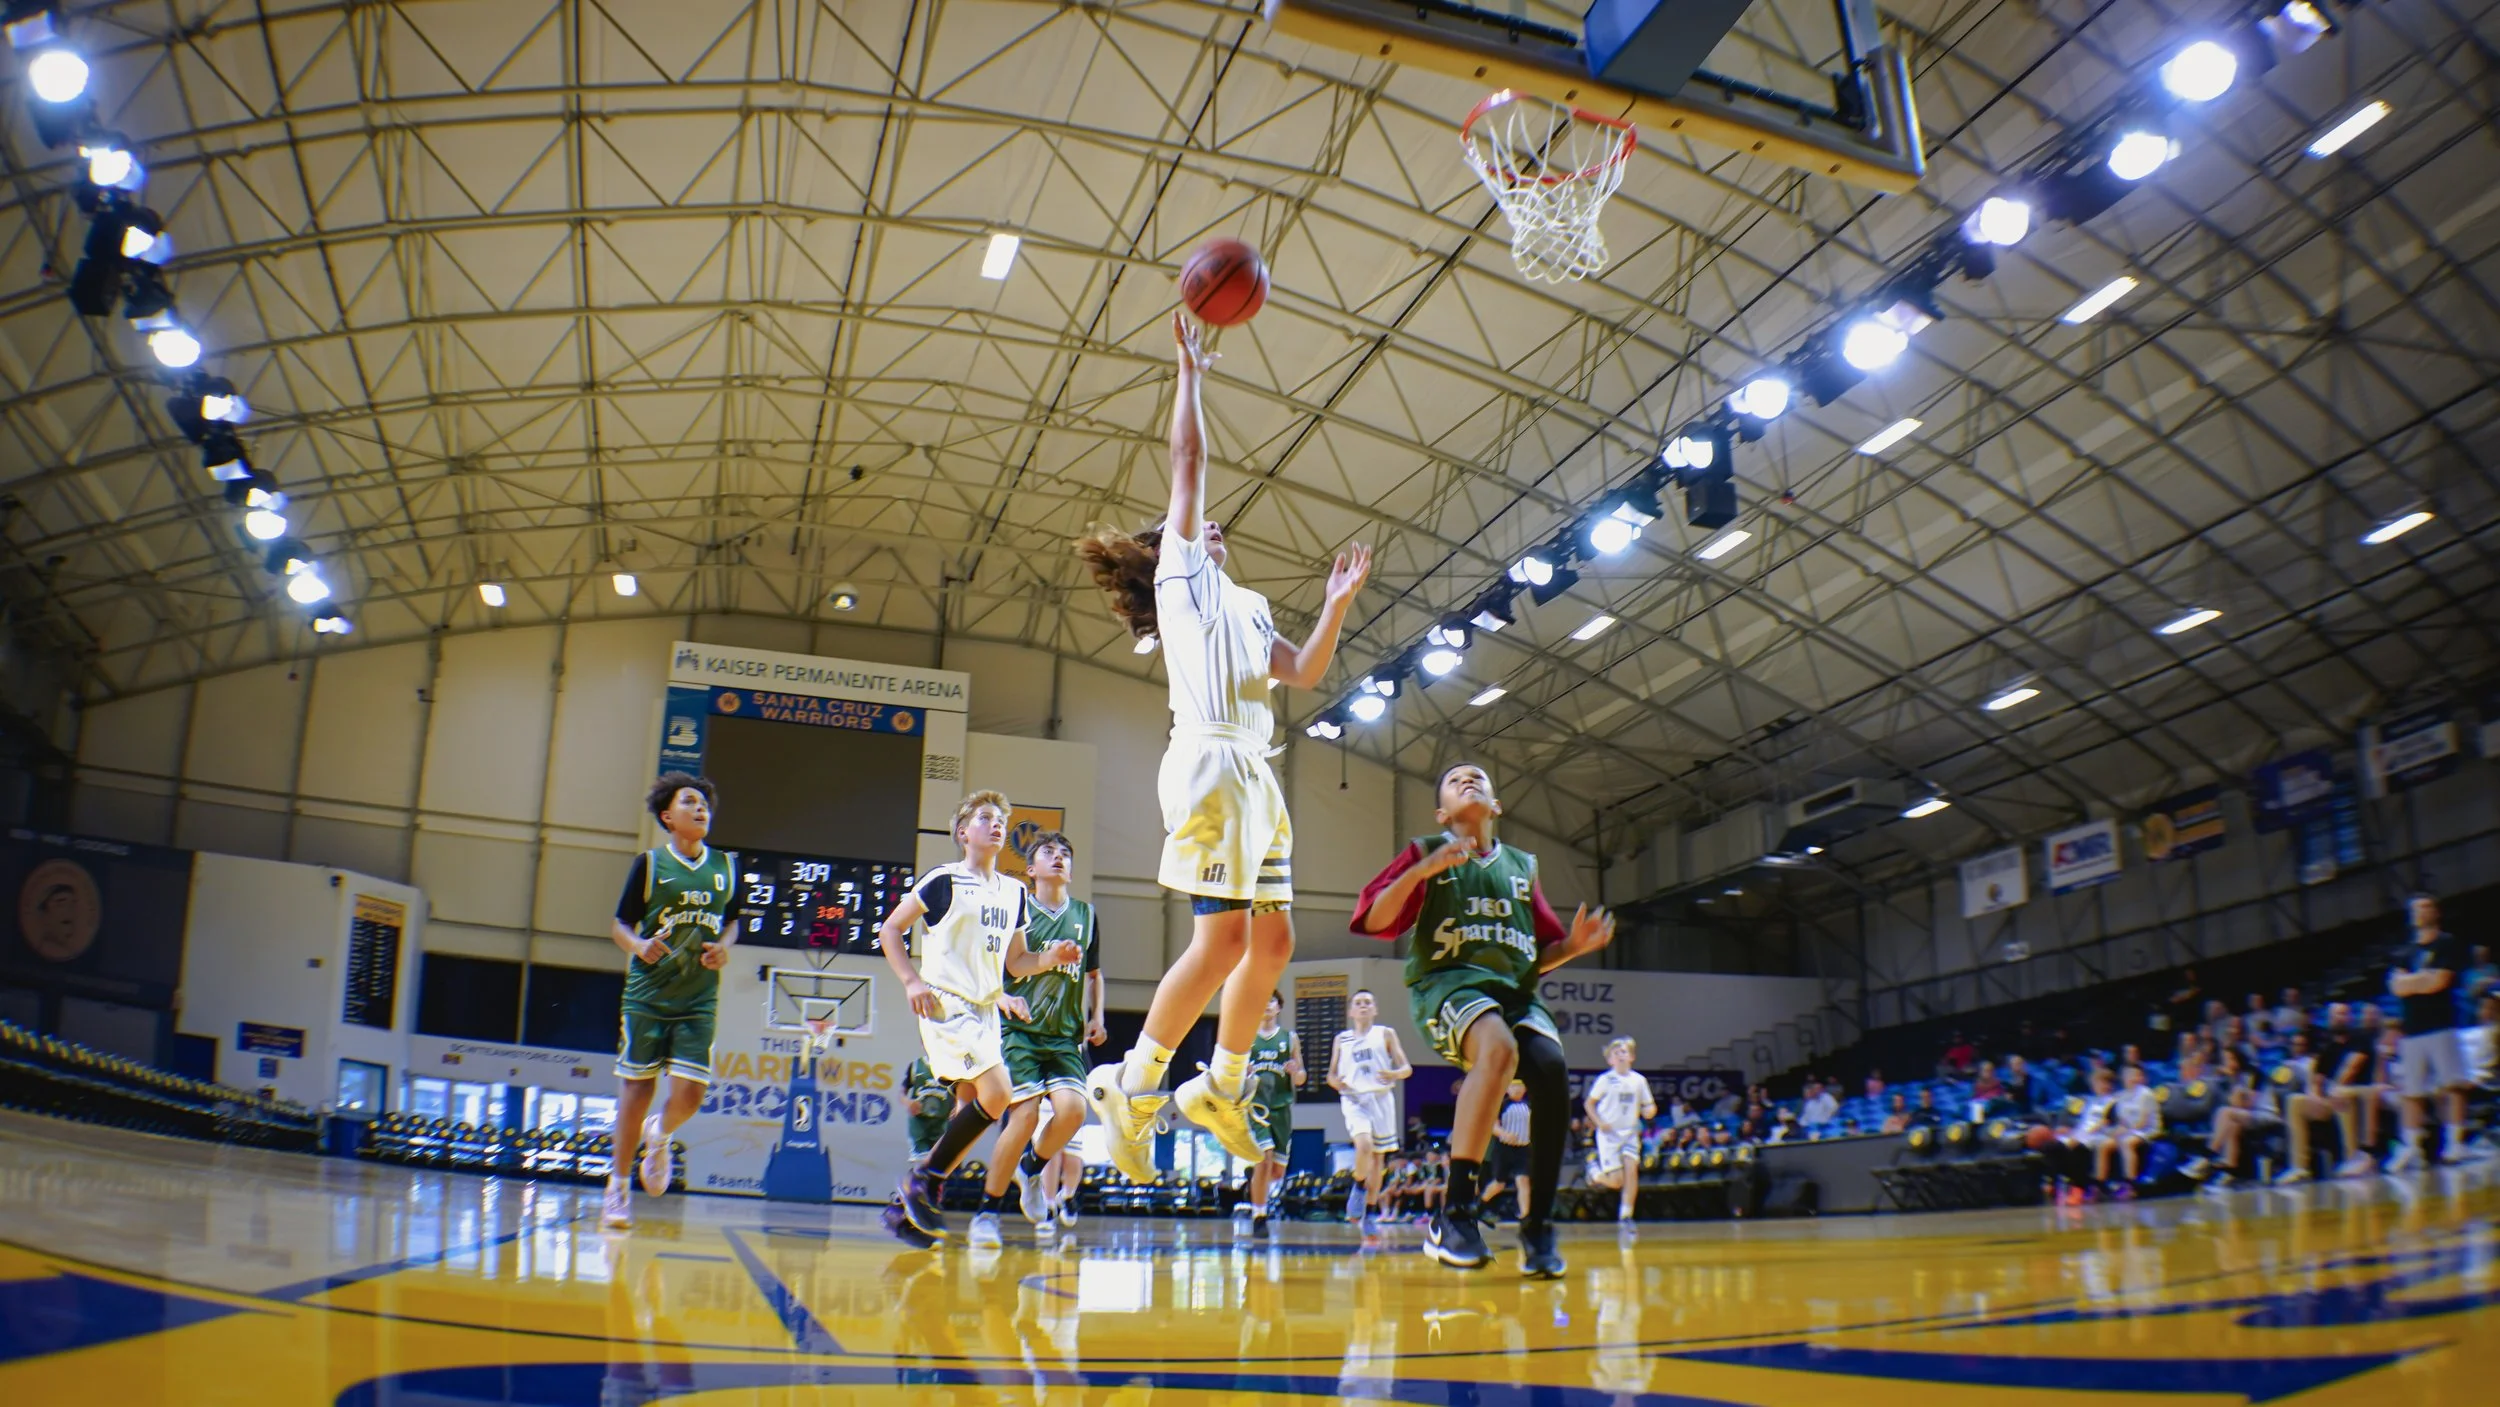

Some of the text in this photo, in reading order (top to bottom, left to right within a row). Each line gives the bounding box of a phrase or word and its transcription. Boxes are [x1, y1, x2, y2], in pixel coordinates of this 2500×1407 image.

[705, 656, 964, 699] KAISER PERMANENTE ARENA
[752, 692, 884, 718] SANTA CRUZ
[761, 707, 873, 730] WARRIORS
[713, 873, 725, 891] 0
[1509, 875, 1531, 901] 12
[746, 884, 776, 905] 23
[654, 907, 723, 935] Spartans
[780, 920, 795, 936] 2
[1074, 923, 1084, 940] 7
[808, 922, 841, 947] 24
[986, 934, 1001, 953] 30
[1431, 917, 1537, 962] Spartans
[1540, 982, 1614, 1002] CRUZ
[760, 1037, 801, 1053] THIS
[714, 1052, 895, 1091] ARORS
[699, 1081, 892, 1125] GROND
